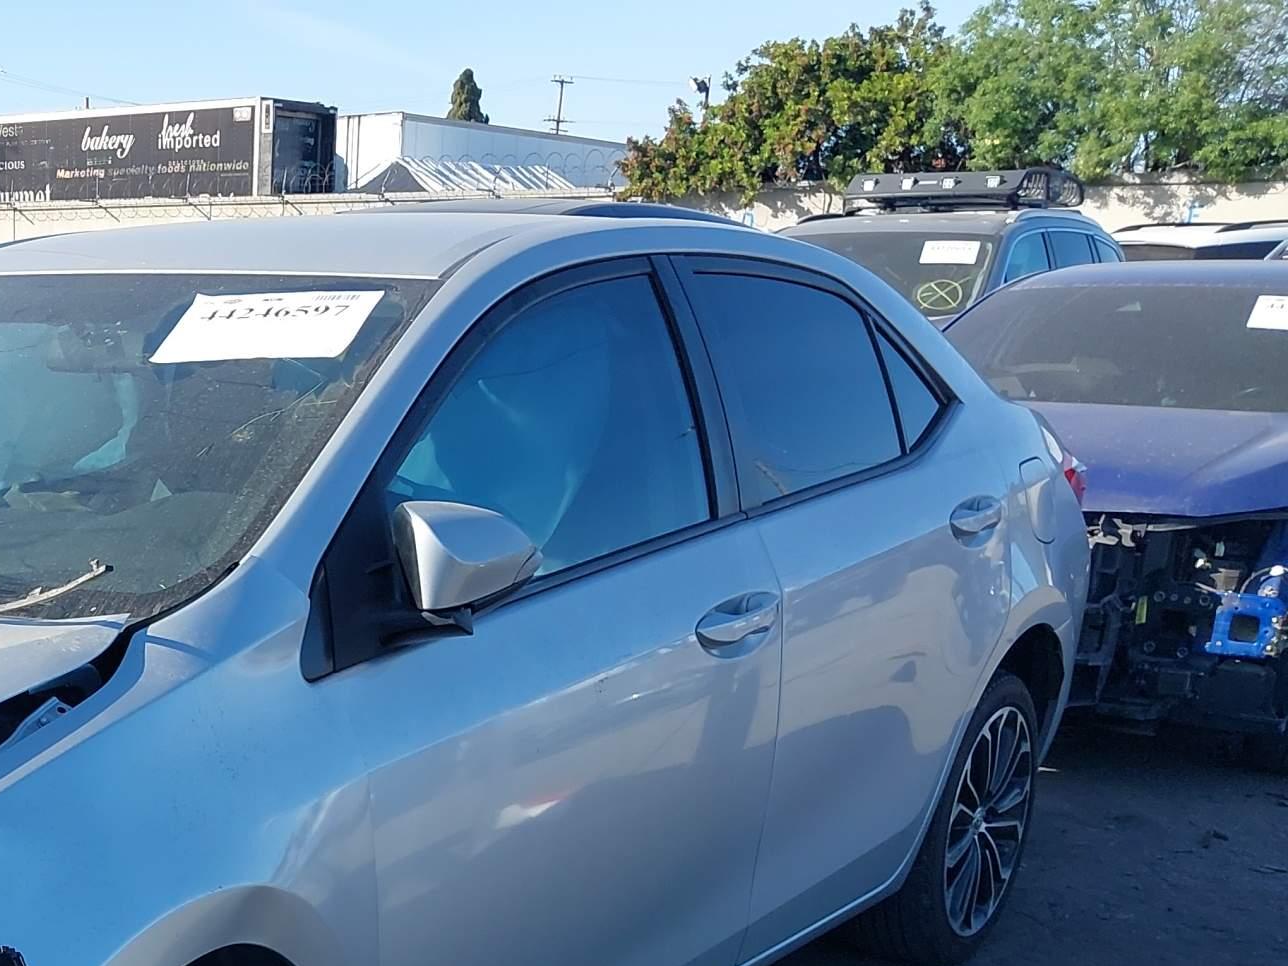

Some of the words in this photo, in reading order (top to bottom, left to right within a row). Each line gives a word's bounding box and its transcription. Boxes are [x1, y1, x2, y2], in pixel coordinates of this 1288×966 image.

[81, 125, 135, 159] bakery
[158, 130, 221, 152] imported
[56, 167, 105, 179] Marketing
[157, 162, 186, 173] foods
[189, 160, 249, 173] nationwide
[200, 304, 351, 321] 44246597
